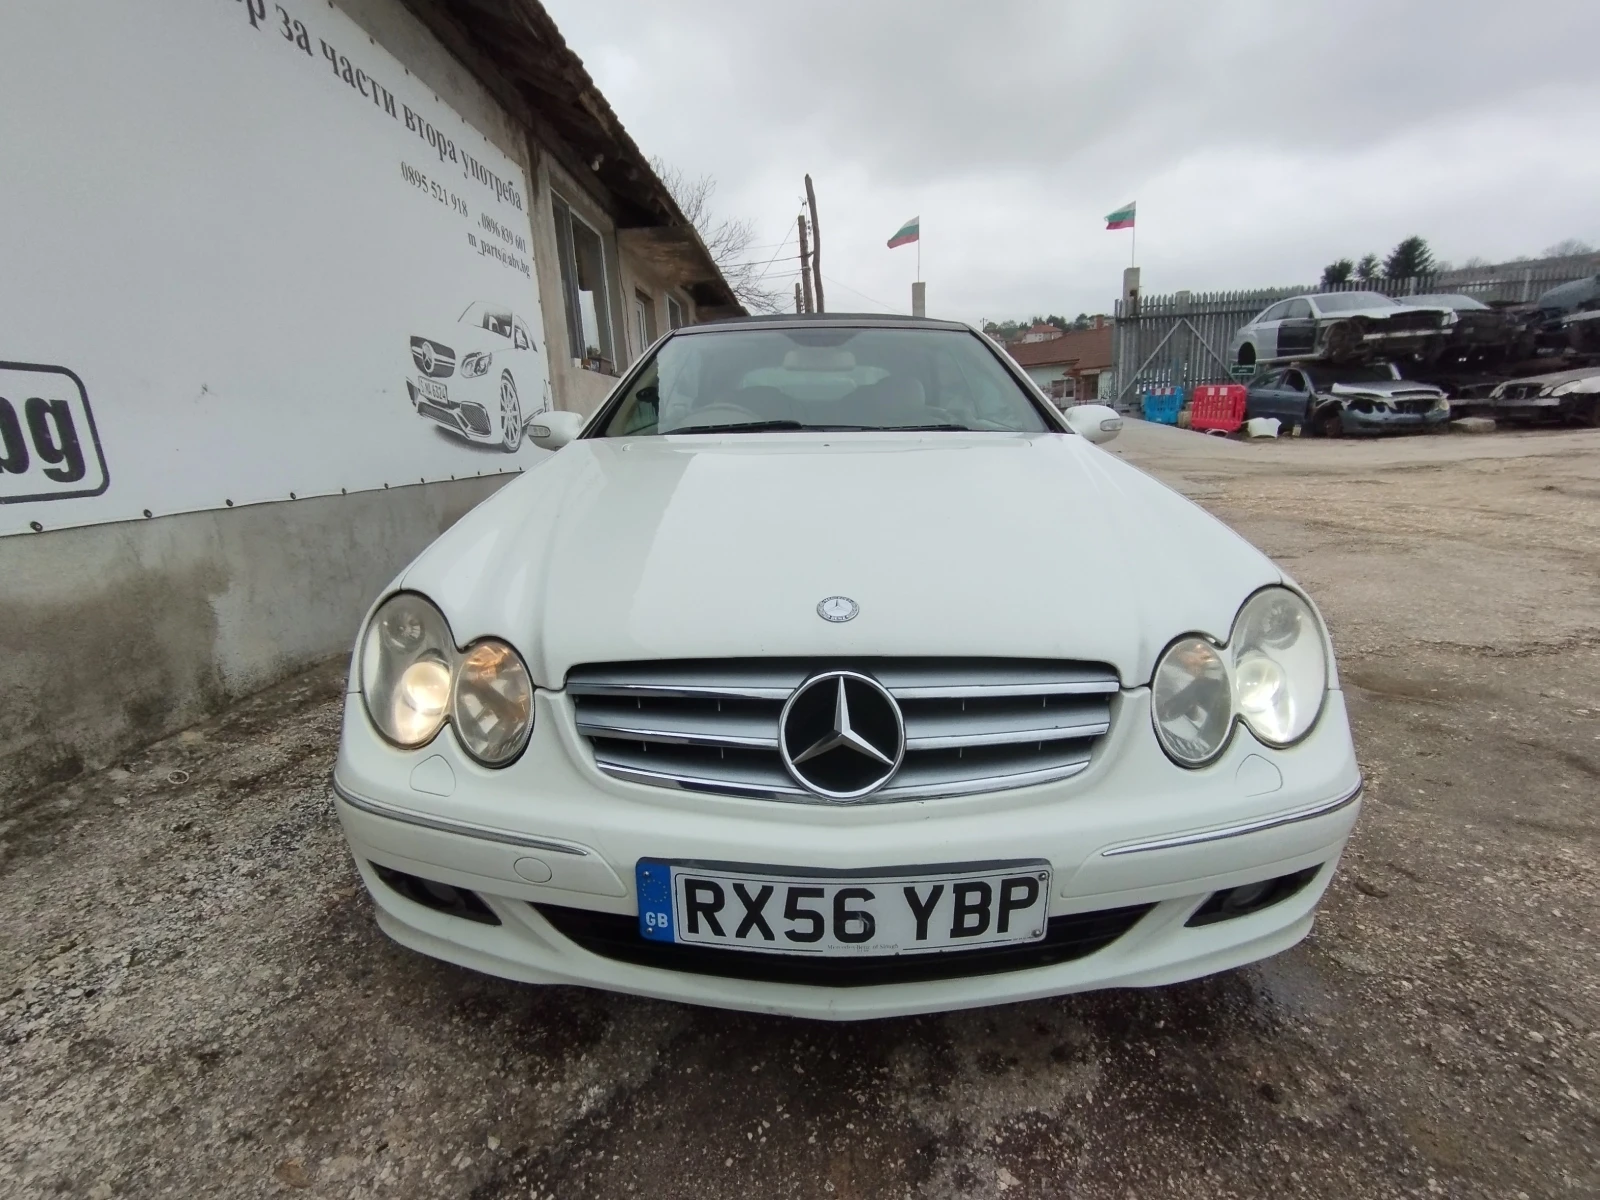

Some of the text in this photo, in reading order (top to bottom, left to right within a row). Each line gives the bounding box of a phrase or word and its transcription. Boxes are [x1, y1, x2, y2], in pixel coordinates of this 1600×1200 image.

[275, 3, 313, 57] за
[319, 38, 398, 120] части
[401, 103, 458, 163] втора
[460, 148, 523, 211] употреба
[401, 161, 429, 193] 0895
[431, 181, 449, 206] 521
[452, 194, 468, 217] 918
[645, 911, 669, 928] GB
[684, 876, 1040, 944] RX56 YBP
